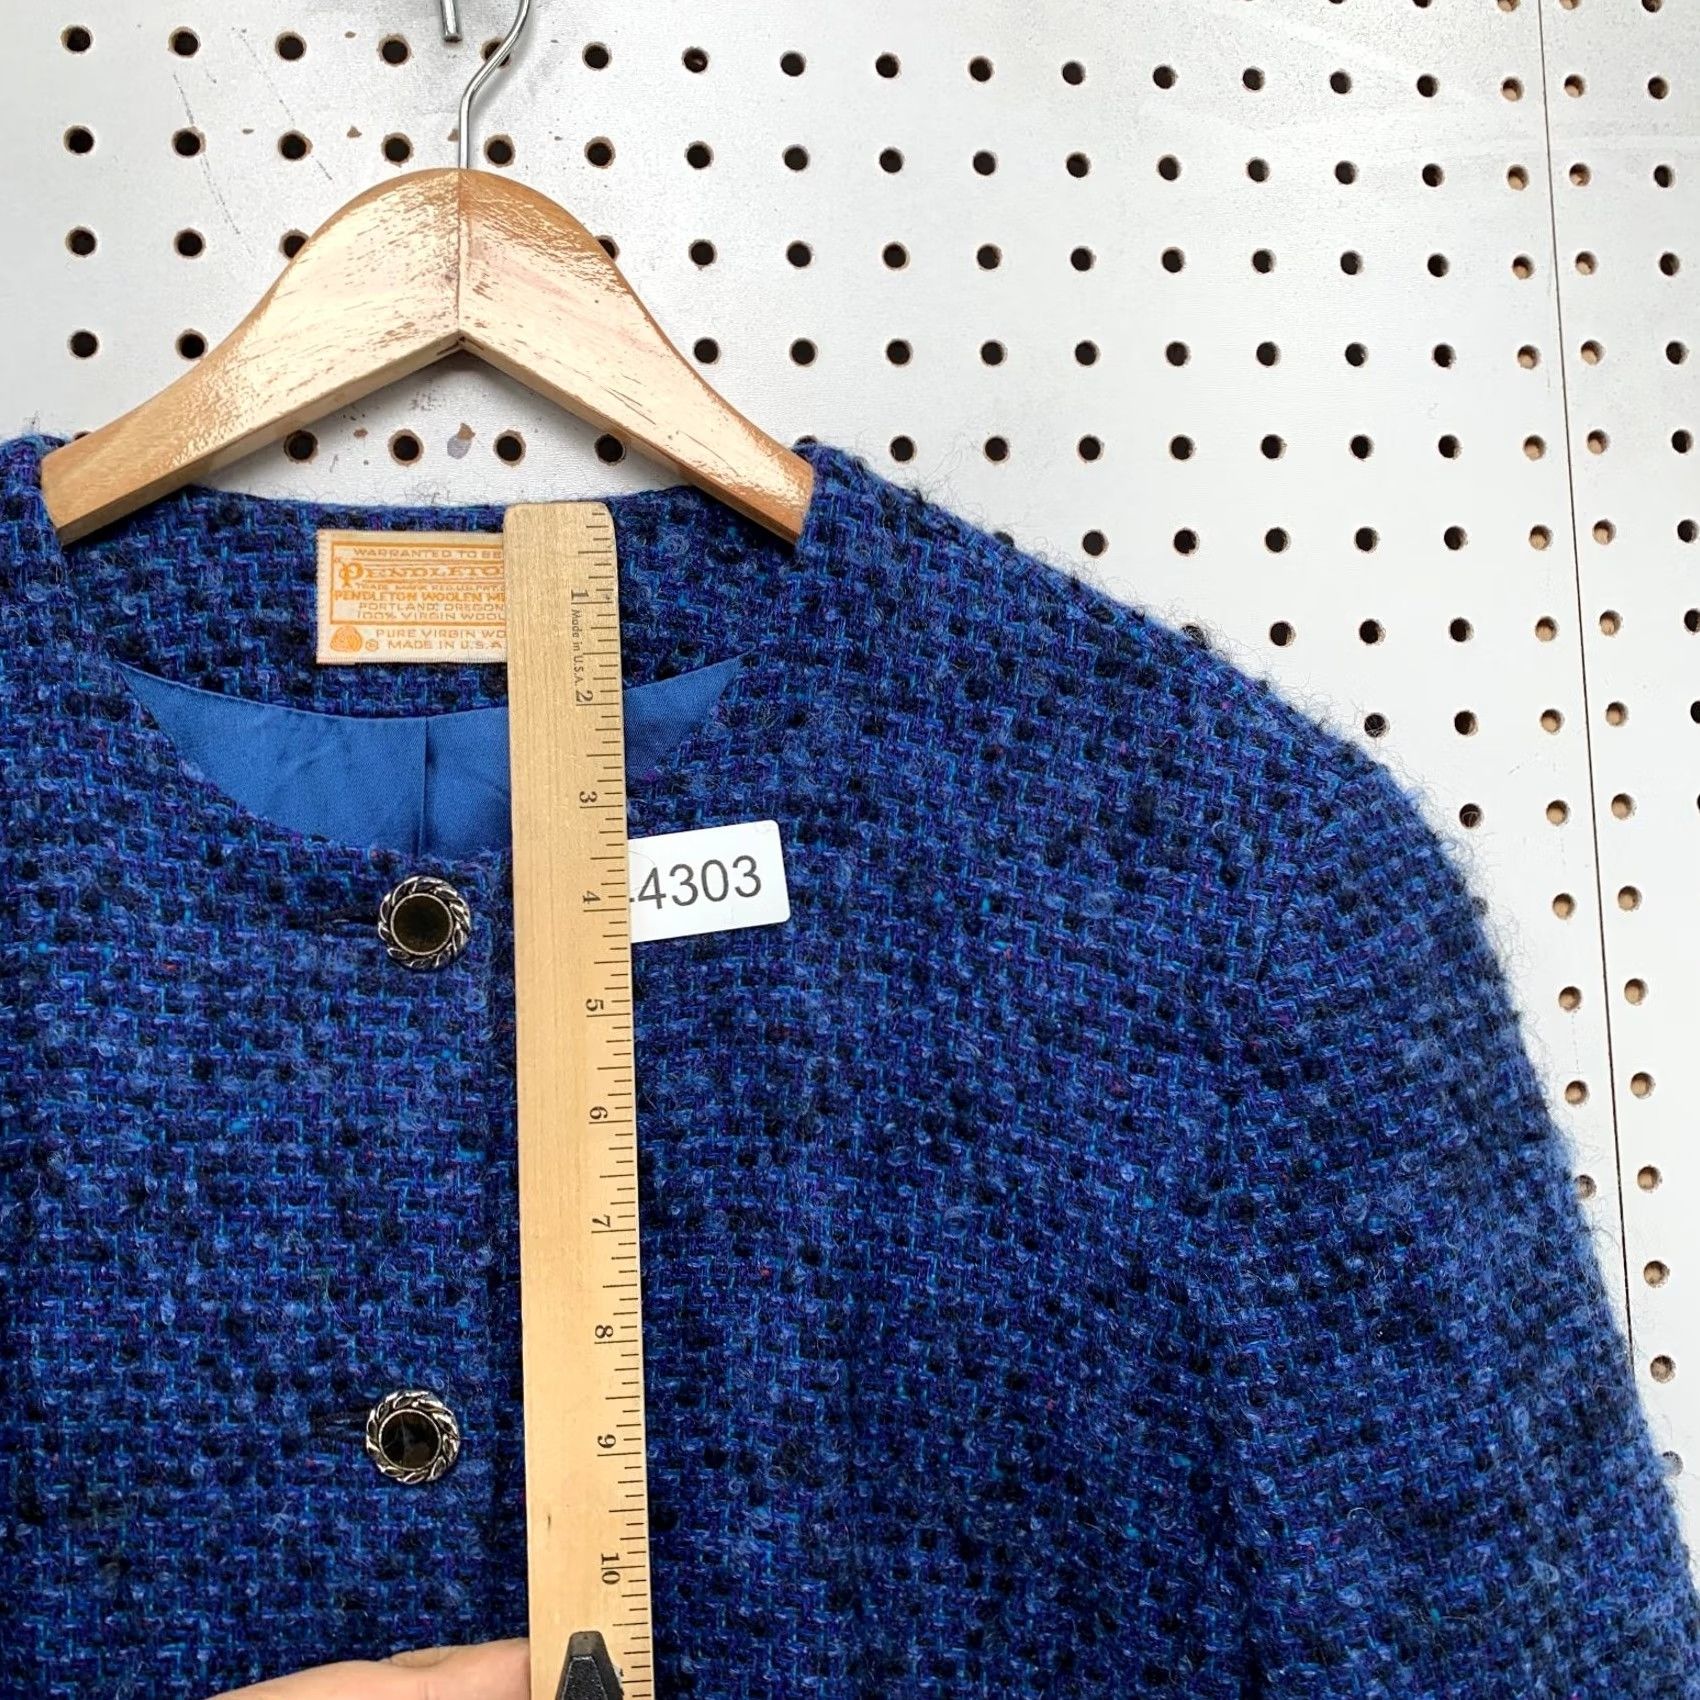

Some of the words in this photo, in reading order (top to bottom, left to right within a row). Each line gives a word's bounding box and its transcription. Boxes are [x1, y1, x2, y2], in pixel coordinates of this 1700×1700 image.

[353, 547, 453, 558] WARRANTED
[458, 549, 477, 559] TO
[481, 550, 502, 559] BE
[338, 561, 504, 587] PENDLETO
[334, 590, 417, 601] PENDLETON
[422, 591, 482, 602] WOOLEN
[571, 589, 589, 600] 1
[444, 603, 504, 612] OREGON
[357, 611, 397, 620] 100%
[401, 612, 456, 620] VIRGIN
[460, 613, 506, 621] WOOL
[572, 608, 582, 638] Made
[376, 629, 416, 638] PURE
[420, 629, 476, 639] VIRGIN
[388, 640, 432, 650] MADE
[439, 641, 455, 650] IN
[575, 690, 593, 703] 2
[579, 790, 598, 803] 3
[628, 855, 762, 910] 4303
[582, 890, 601, 905] 4
[585, 998, 604, 1012] 5
[589, 1106, 608, 1120] 6
[592, 1214, 611, 1228] 7
[594, 1324, 614, 1339] 8
[597, 1434, 617, 1449] 9
[600, 1552, 621, 1585] 10
